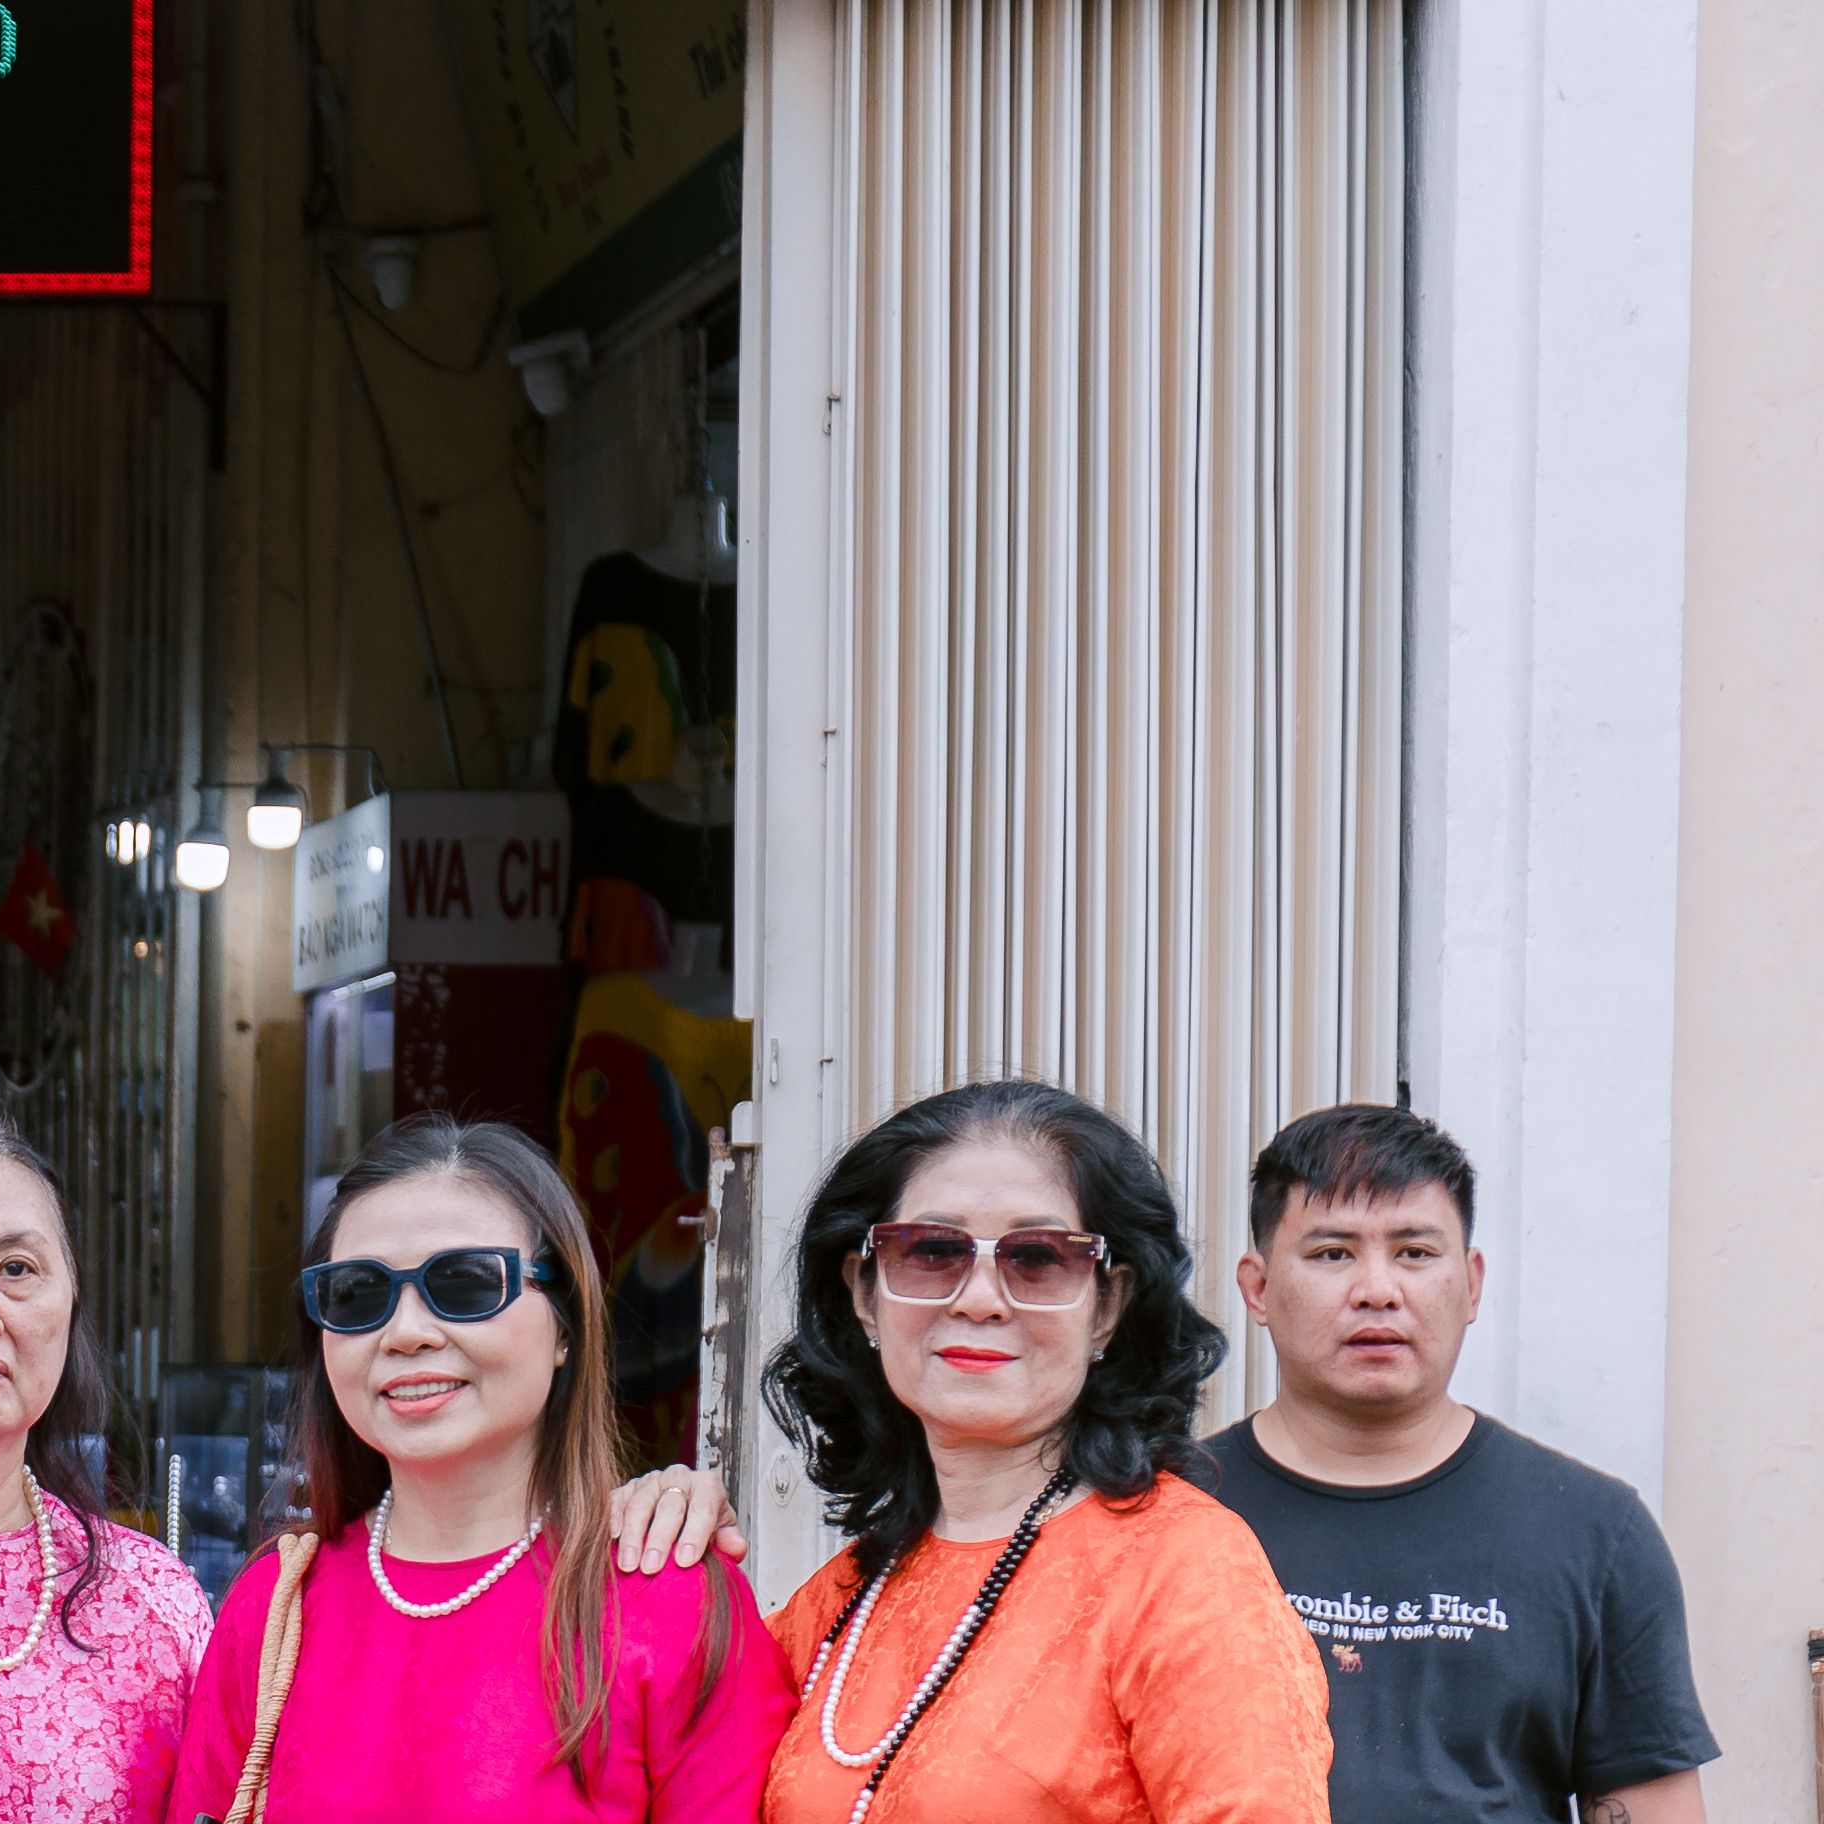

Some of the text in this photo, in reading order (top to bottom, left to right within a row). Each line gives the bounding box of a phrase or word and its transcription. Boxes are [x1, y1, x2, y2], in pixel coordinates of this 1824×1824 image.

[1395, 1600, 1422, 1623] &
[1427, 1593, 1509, 1632] Fitch
[1332, 1623, 1350, 1640] IN
[1352, 1626, 1389, 1642] NEW
[1390, 1623, 1435, 1641] YORK
[1438, 1624, 1475, 1643] CITY
